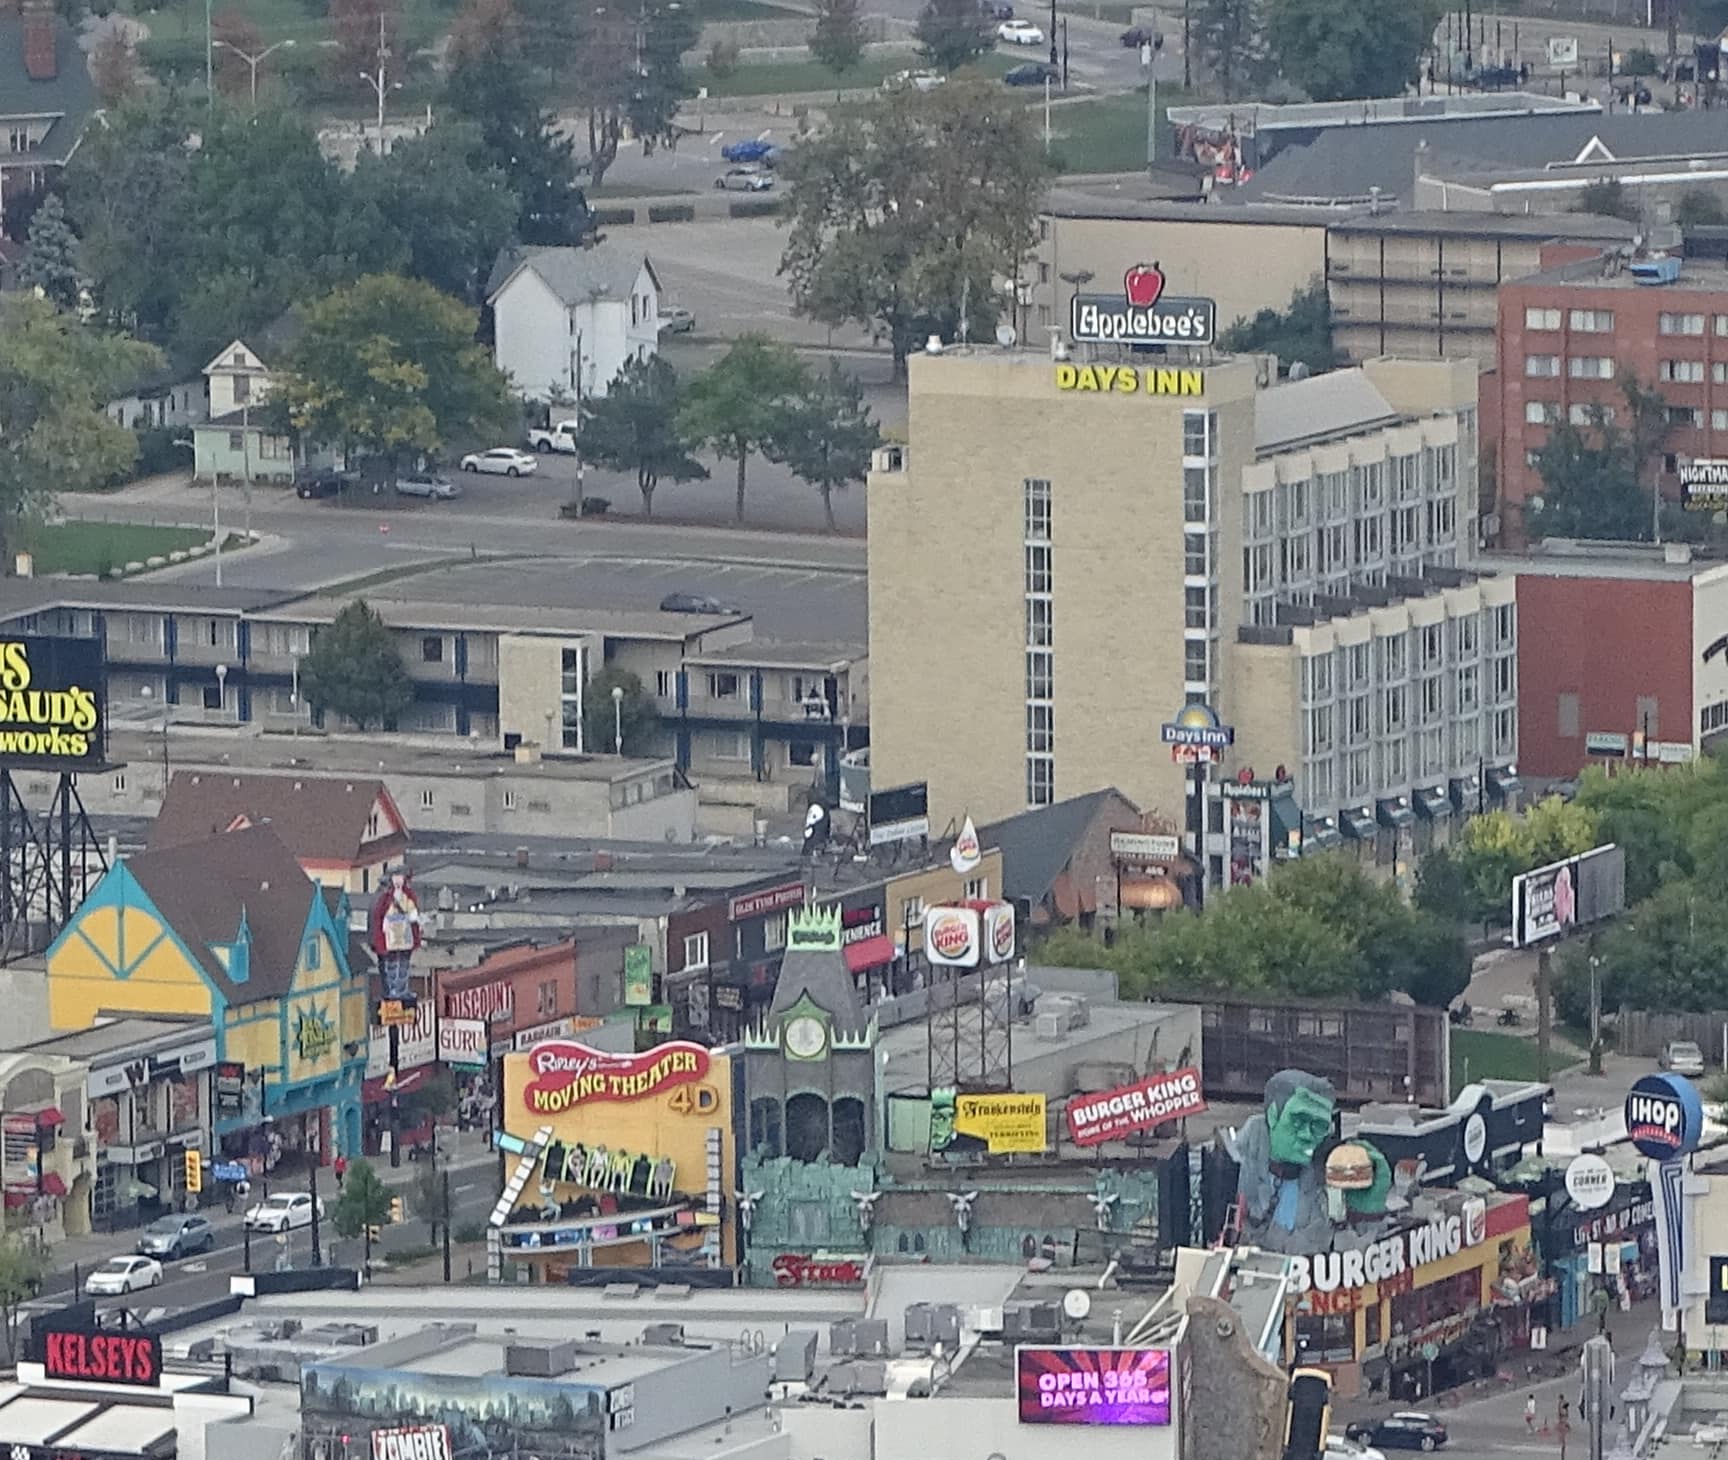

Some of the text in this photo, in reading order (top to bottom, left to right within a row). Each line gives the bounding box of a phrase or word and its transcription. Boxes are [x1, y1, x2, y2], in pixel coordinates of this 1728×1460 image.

[1079, 306, 1205, 341] Applebee's
[1056, 366, 1205, 396] DAYS INN
[1165, 729, 1228, 746] Days Inn
[935, 932, 970, 948] KING
[533, 1051, 698, 1113] MOVING THEATER
[668, 1083, 720, 1117] 4D
[961, 1099, 1044, 1122] Frankenstein
[1072, 1073, 1197, 1126] BURGER KING
[1077, 1124, 1102, 1139] HOME
[1102, 1121, 1113, 1133] OF
[1129, 1090, 1201, 1123] WHOPPER
[1632, 1097, 1680, 1133] IHOP
[1286, 1237, 1406, 1293] BURGER
[1408, 1217, 1462, 1269] KING
[45, 1332, 155, 1381] KELSEYS
[1037, 1369, 1148, 1392] OPEN 365
[1039, 1388, 1150, 1409] DAYS A YEAR
